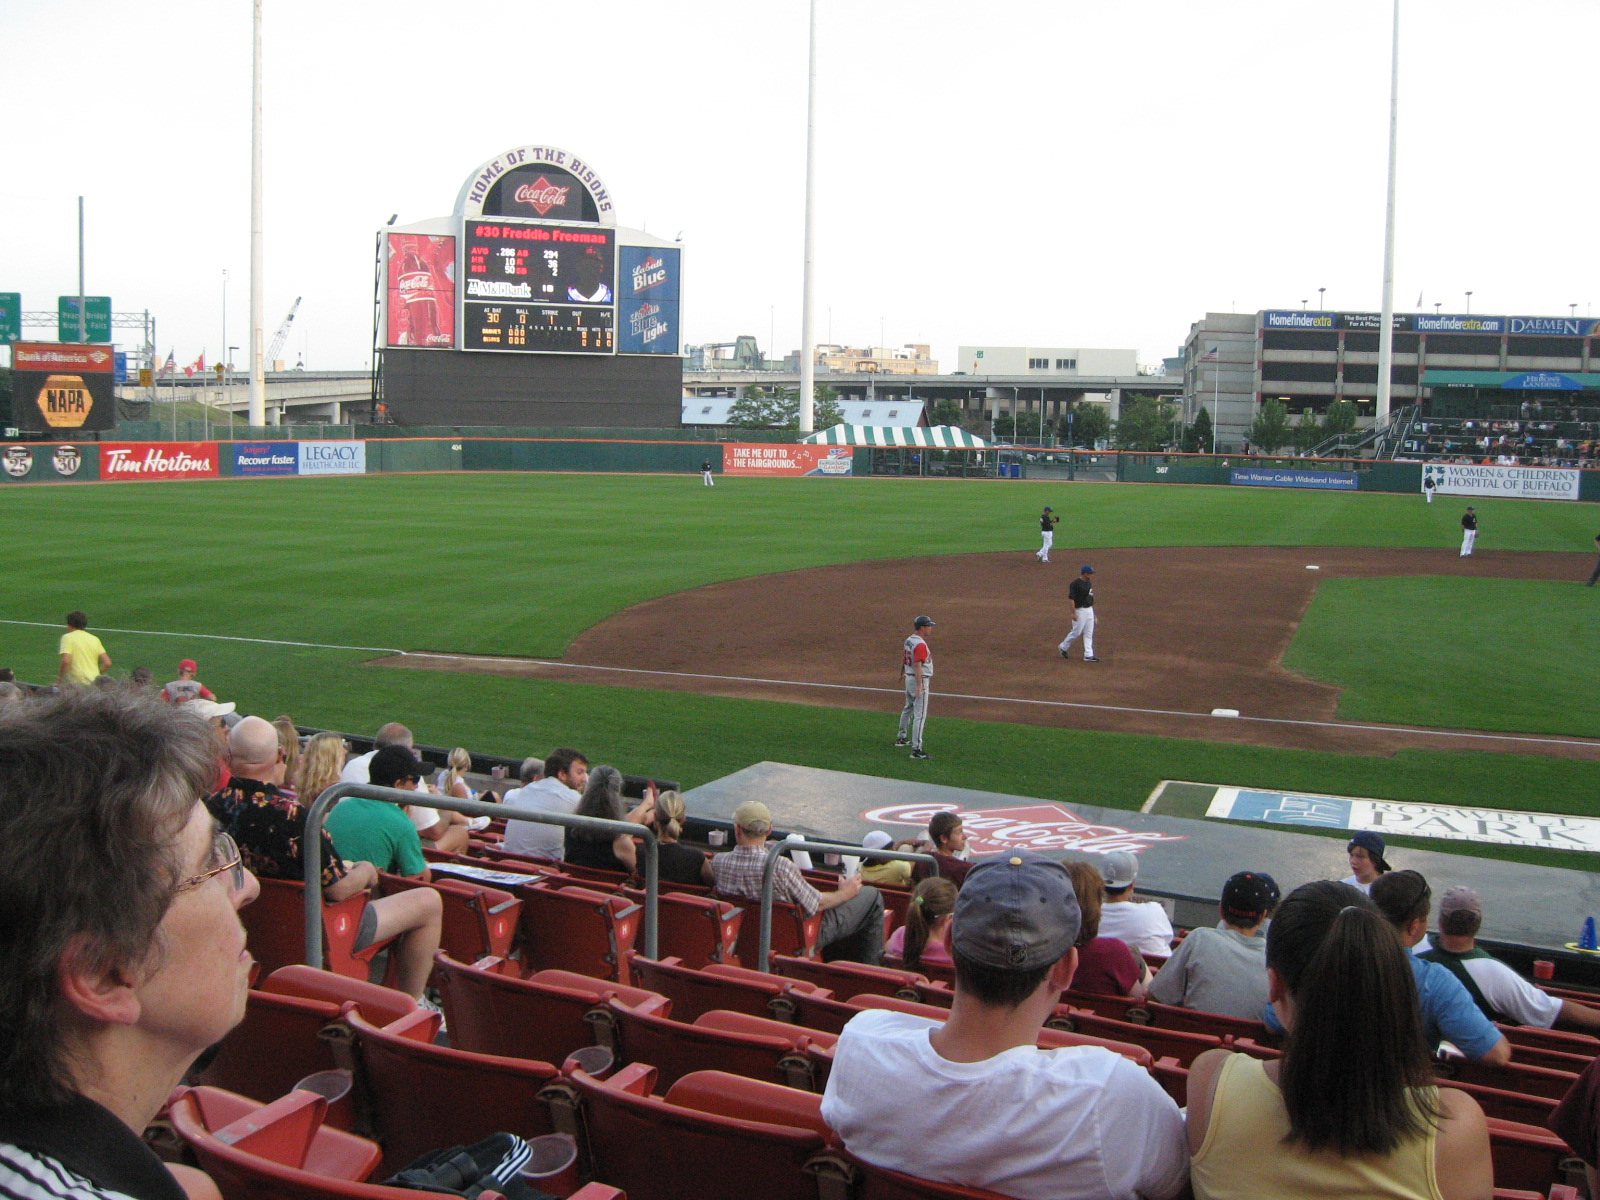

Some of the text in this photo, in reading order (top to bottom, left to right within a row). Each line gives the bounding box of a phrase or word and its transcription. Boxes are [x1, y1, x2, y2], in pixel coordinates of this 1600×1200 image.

[470, 148, 612, 212] HOME OF THE BISONS
[515, 184, 570, 205] Coca-Cola
[476, 226, 606, 244] #30 Freddie Freeman
[506, 258, 515, 266] 10
[632, 258, 663, 276] Labatt
[505, 266, 515, 274] 50
[552, 268, 558, 276] 2
[633, 270, 666, 290] Blue
[487, 313, 499, 322] 30
[1269, 313, 1332, 327] Homefinderextra
[1418, 317, 1498, 331] Homefinderextra.com
[644, 322, 668, 344] Light
[1511, 319, 1580, 334] DAEMEN
[17, 351, 40, 361] Bank
[50, 352, 87, 362] America
[48, 390, 84, 412] NAPA
[238, 455, 295, 465] Recover faster.
[306, 447, 359, 460] LEGACY
[734, 448, 787, 458] TAKE ME OUT TO
[9, 459, 28, 472] 25
[58, 457, 77, 471] 30
[107, 448, 210, 473] Tim Hortons
[733, 458, 801, 468] THE FAIRGROUNDS...
[1450, 467, 1576, 480] WOMEN & CHILDREN'S
[1448, 477, 1571, 491] HOSPITAL OF BUFFALO
[1371, 802, 1584, 830] ROSWELL
[1373, 811, 1595, 844] PARK
[340, 918, 345, 930] J
[622, 924, 627, 935] H
